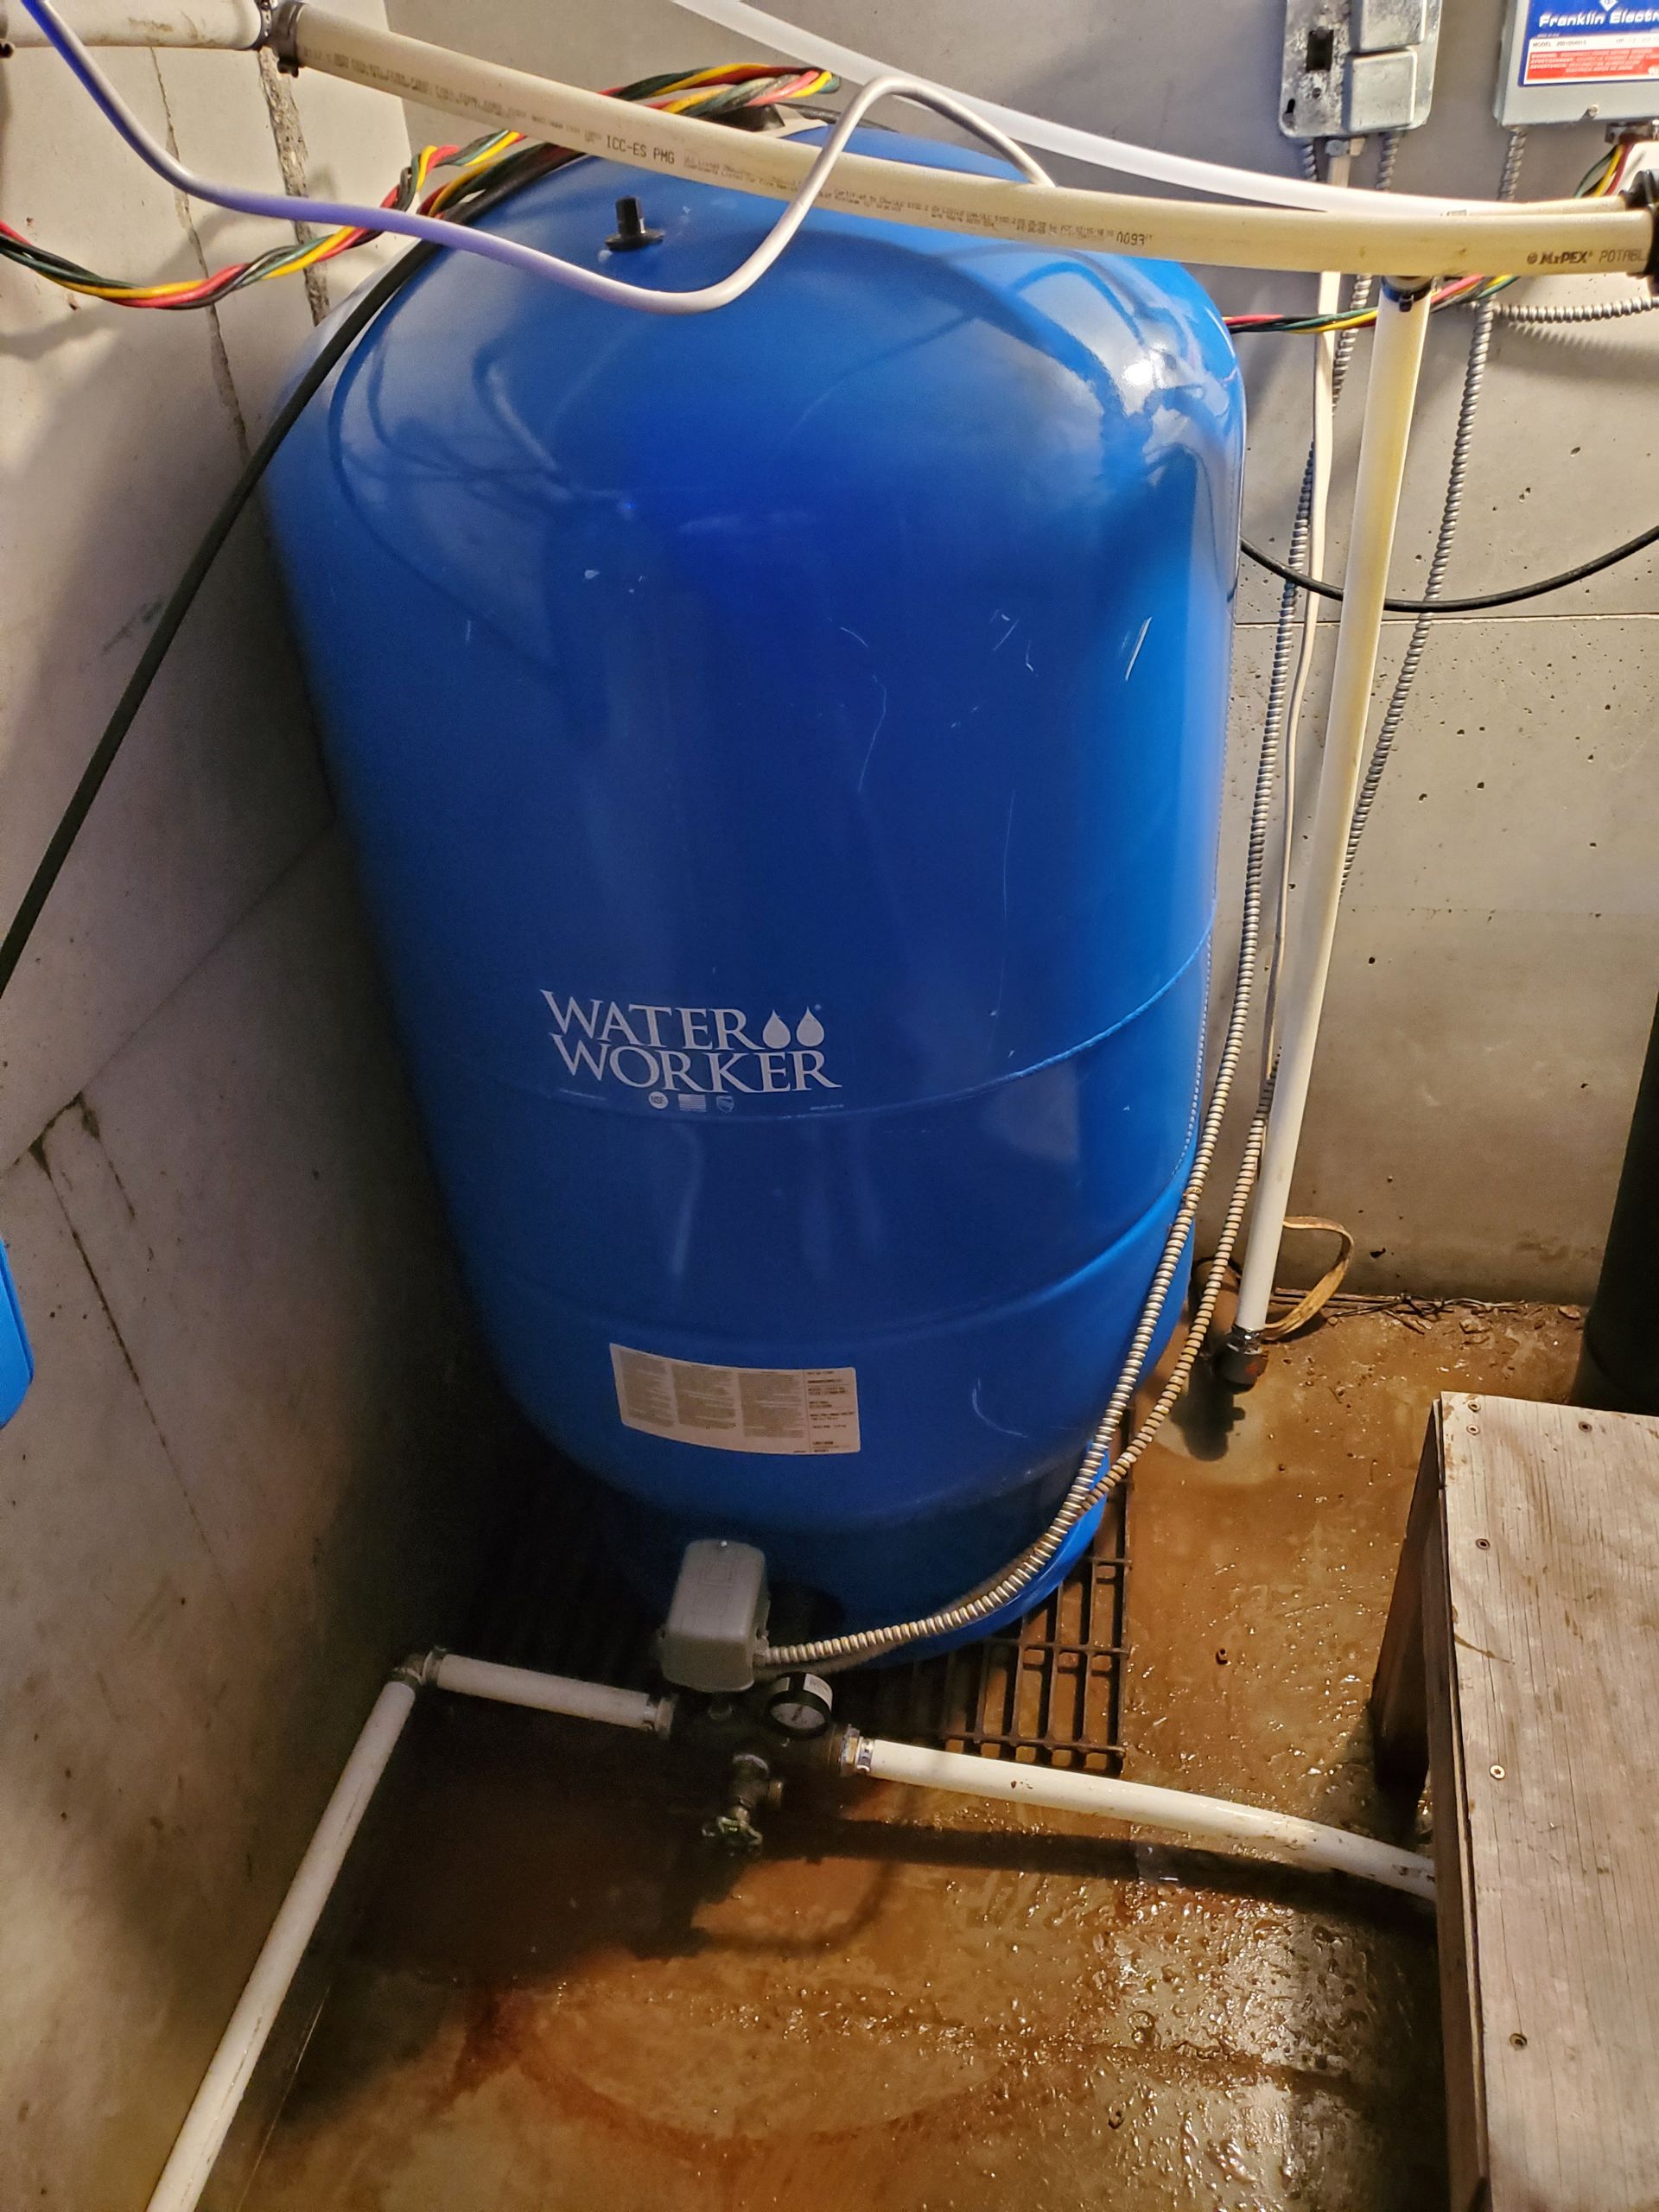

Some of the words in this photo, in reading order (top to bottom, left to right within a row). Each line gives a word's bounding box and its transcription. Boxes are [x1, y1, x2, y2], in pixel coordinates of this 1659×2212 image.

[1539, 10, 1606, 27] Franklin
[607, 135, 647, 158] ICC-ES
[653, 147, 675, 164] PMG
[539, 988, 766, 1052] WATER
[549, 1032, 842, 1094] WORKER
